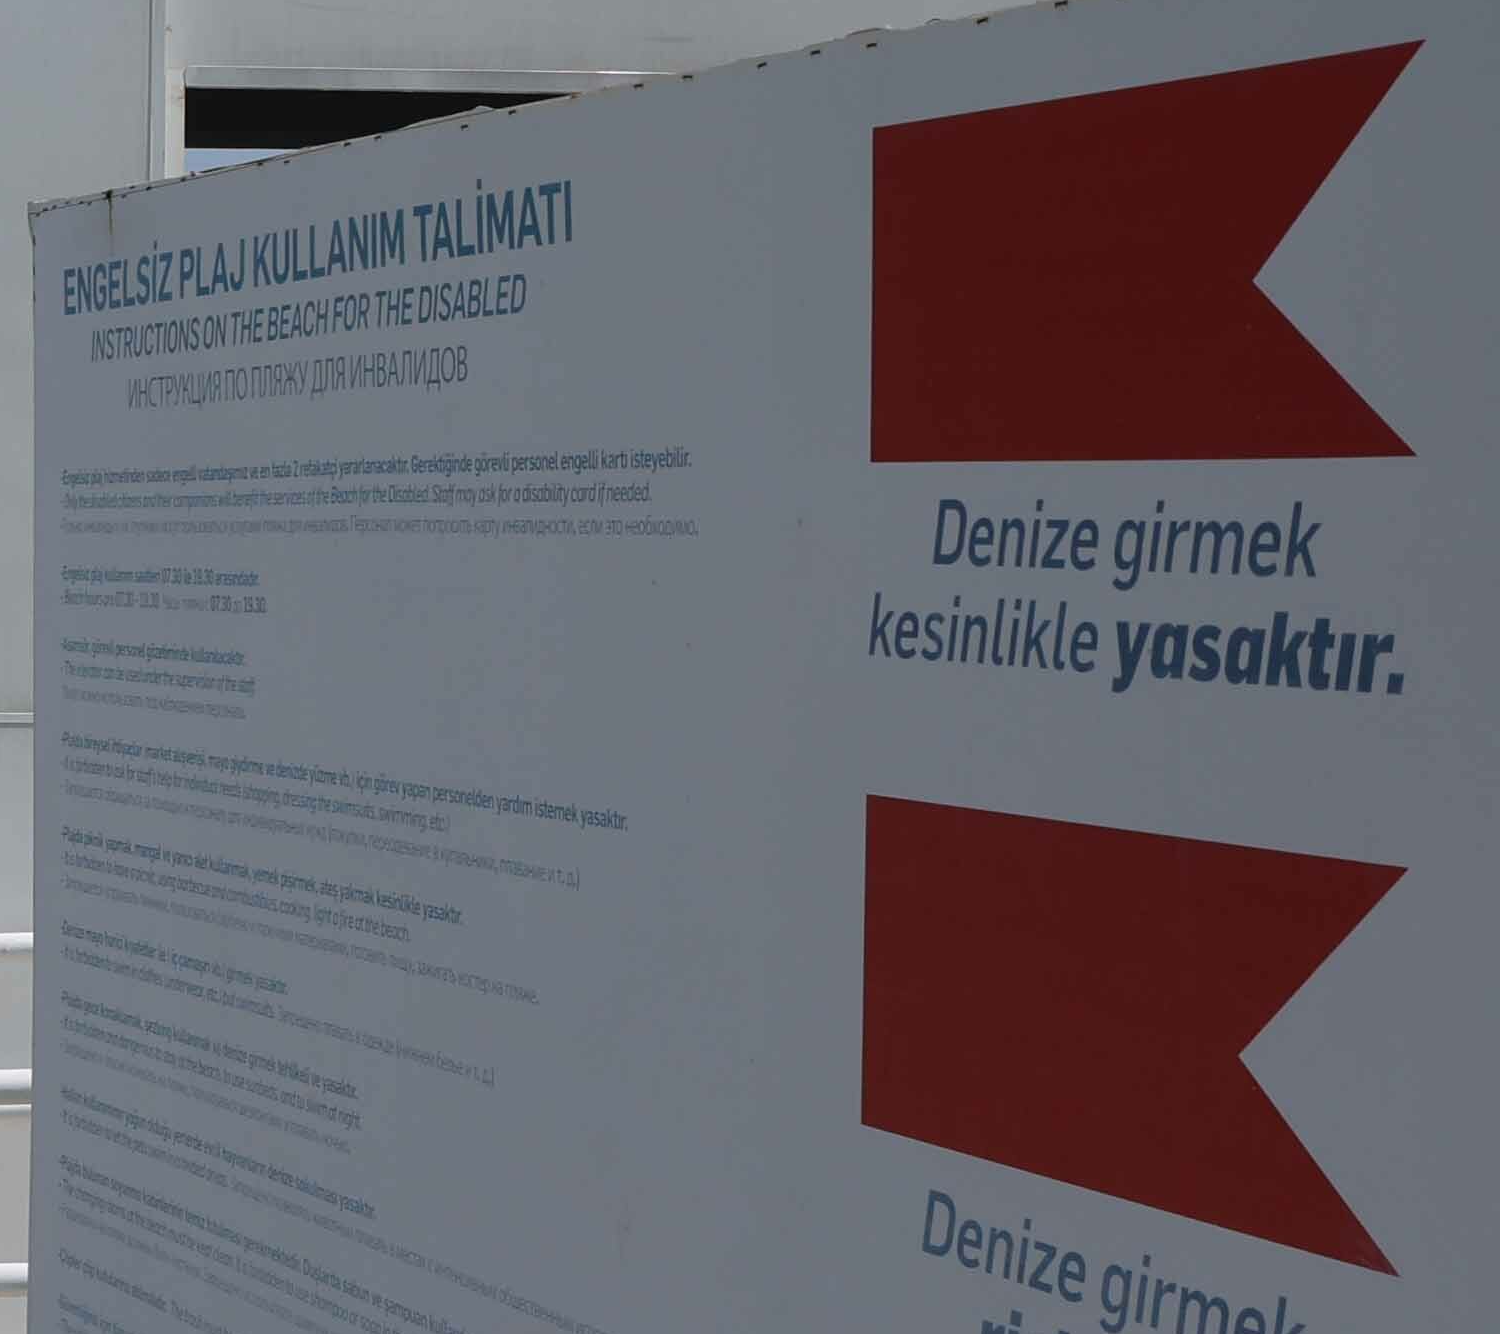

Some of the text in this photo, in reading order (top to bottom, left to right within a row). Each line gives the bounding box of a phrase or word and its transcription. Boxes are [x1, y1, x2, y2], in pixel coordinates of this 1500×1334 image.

[63, 178, 573, 316] ENGELSİZ PLAJ KULLANIM TALİMATI
[91, 273, 528, 363] INSTRUCTIONS ON THE BEACH FOR THE DISABLED
[127, 345, 469, 410] ИНСТРУКЦИЯ ПО ПЛЯЖУ ДЛЯ ИНВАЛИДОВ
[511, 450, 559, 476] personel
[561, 449, 599, 475] engelli
[600, 448, 629, 469] kartı
[630, 446, 693, 473] isteyebilir.
[932, 497, 1322, 591] Denize girmek
[868, 592, 1406, 696] kesinlikle yasaktır.
[580, 807, 628, 832] yasaktır.
[921, 1189, 1087, 1305] Denize
